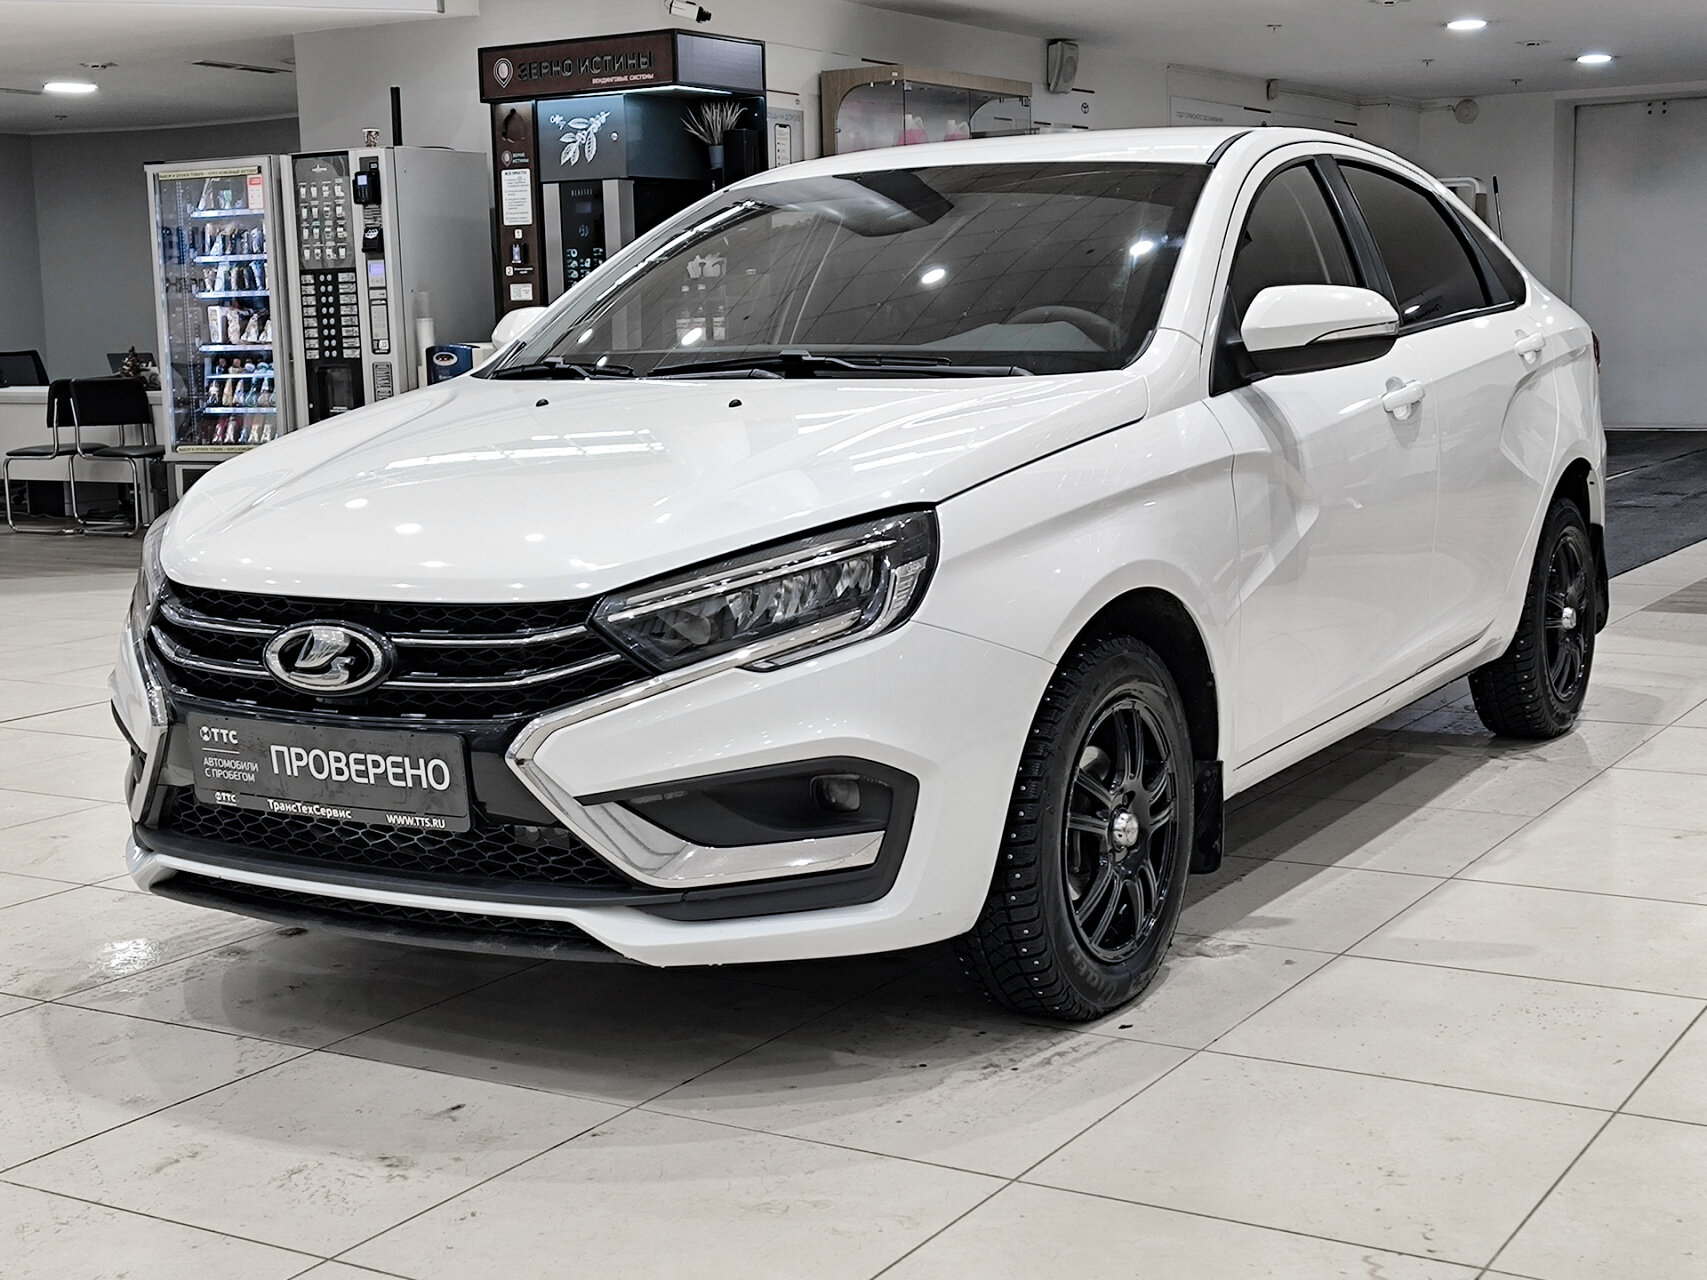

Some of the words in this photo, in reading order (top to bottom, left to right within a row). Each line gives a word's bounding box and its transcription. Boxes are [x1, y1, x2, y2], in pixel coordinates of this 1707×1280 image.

[518, 59, 573, 81] ЗЕРНО
[578, 51, 654, 74] ИСТИНЫ
[629, 73, 654, 81] СИСТЕМЫ
[211, 728, 239, 745] ТТС
[203, 757, 259, 772] АВТОМОБИЛИ
[270, 744, 451, 791] ПРОВЕРЕНО
[204, 768, 211, 778] С
[212, 769, 256, 782] ПРОБЕГОМ
[220, 793, 237, 803] ТТС
[267, 799, 352, 819] ТрансТехСервис
[385, 813, 446, 829] WWW.TTS.RU
